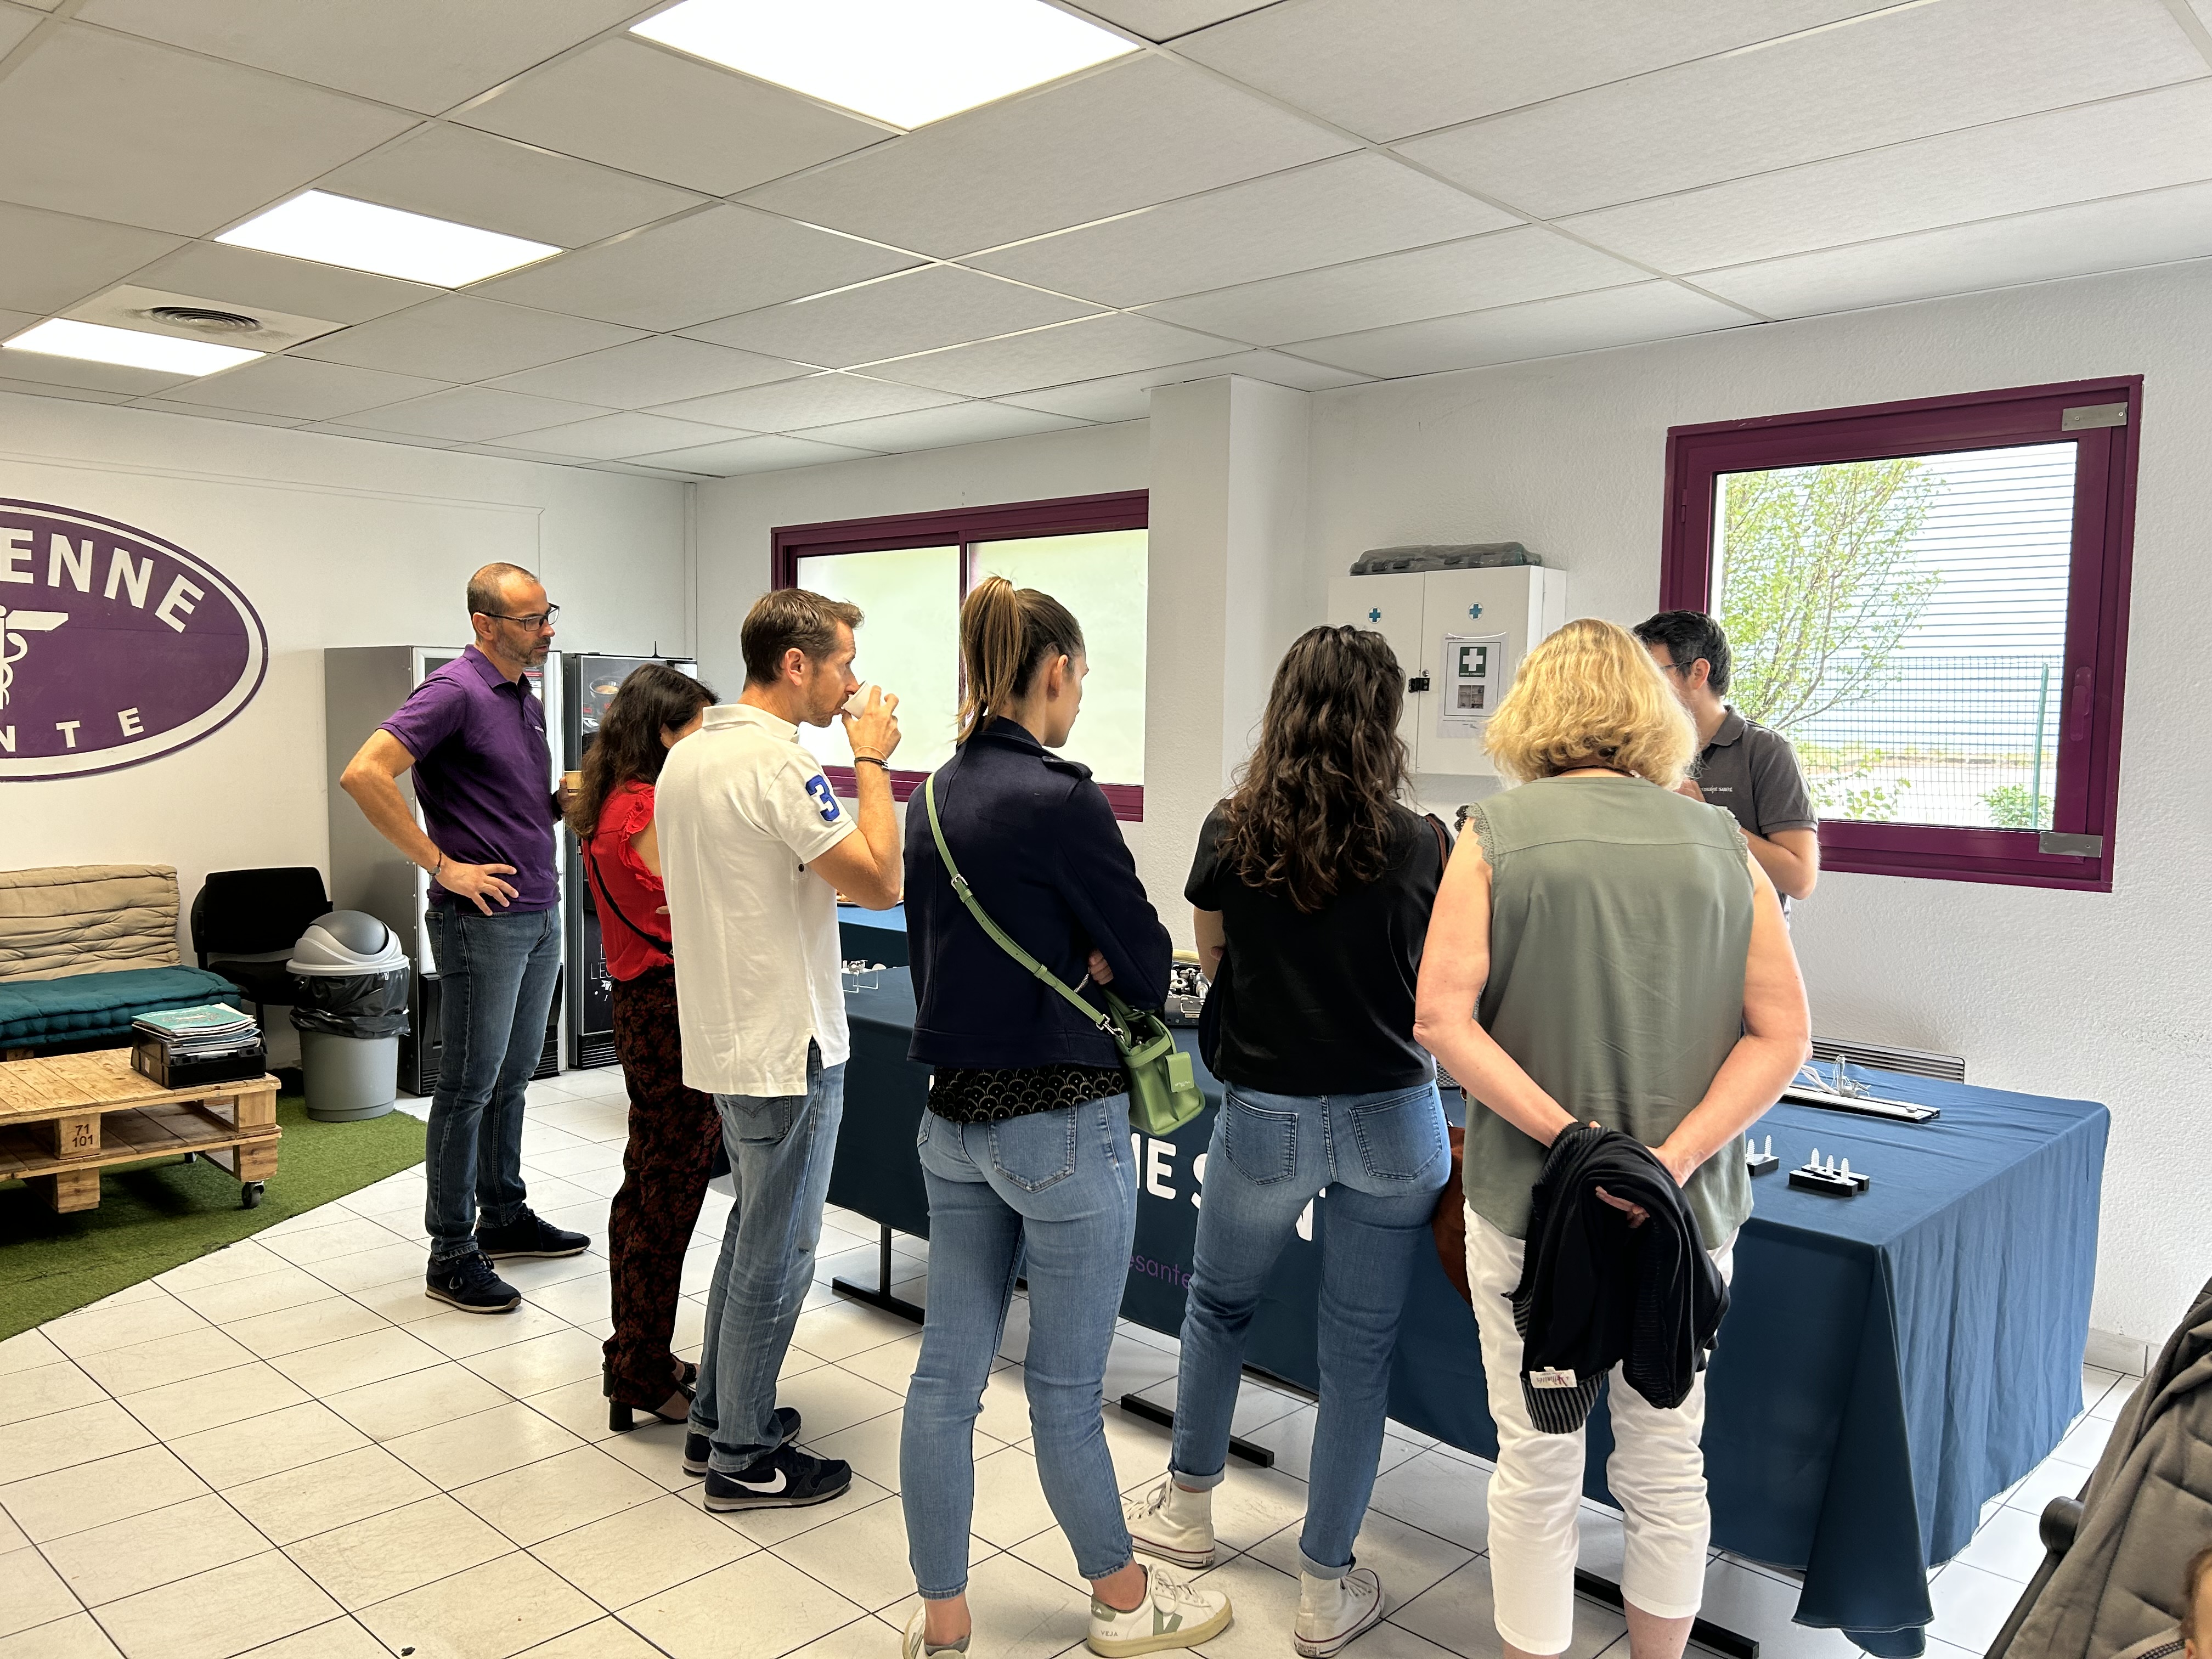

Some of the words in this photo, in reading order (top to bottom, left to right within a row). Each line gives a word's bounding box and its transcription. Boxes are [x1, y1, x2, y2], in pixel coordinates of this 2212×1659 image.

[805, 774, 840, 821] 3
[75, 1124, 89, 1136] 71
[72, 1135, 93, 1148] 101
